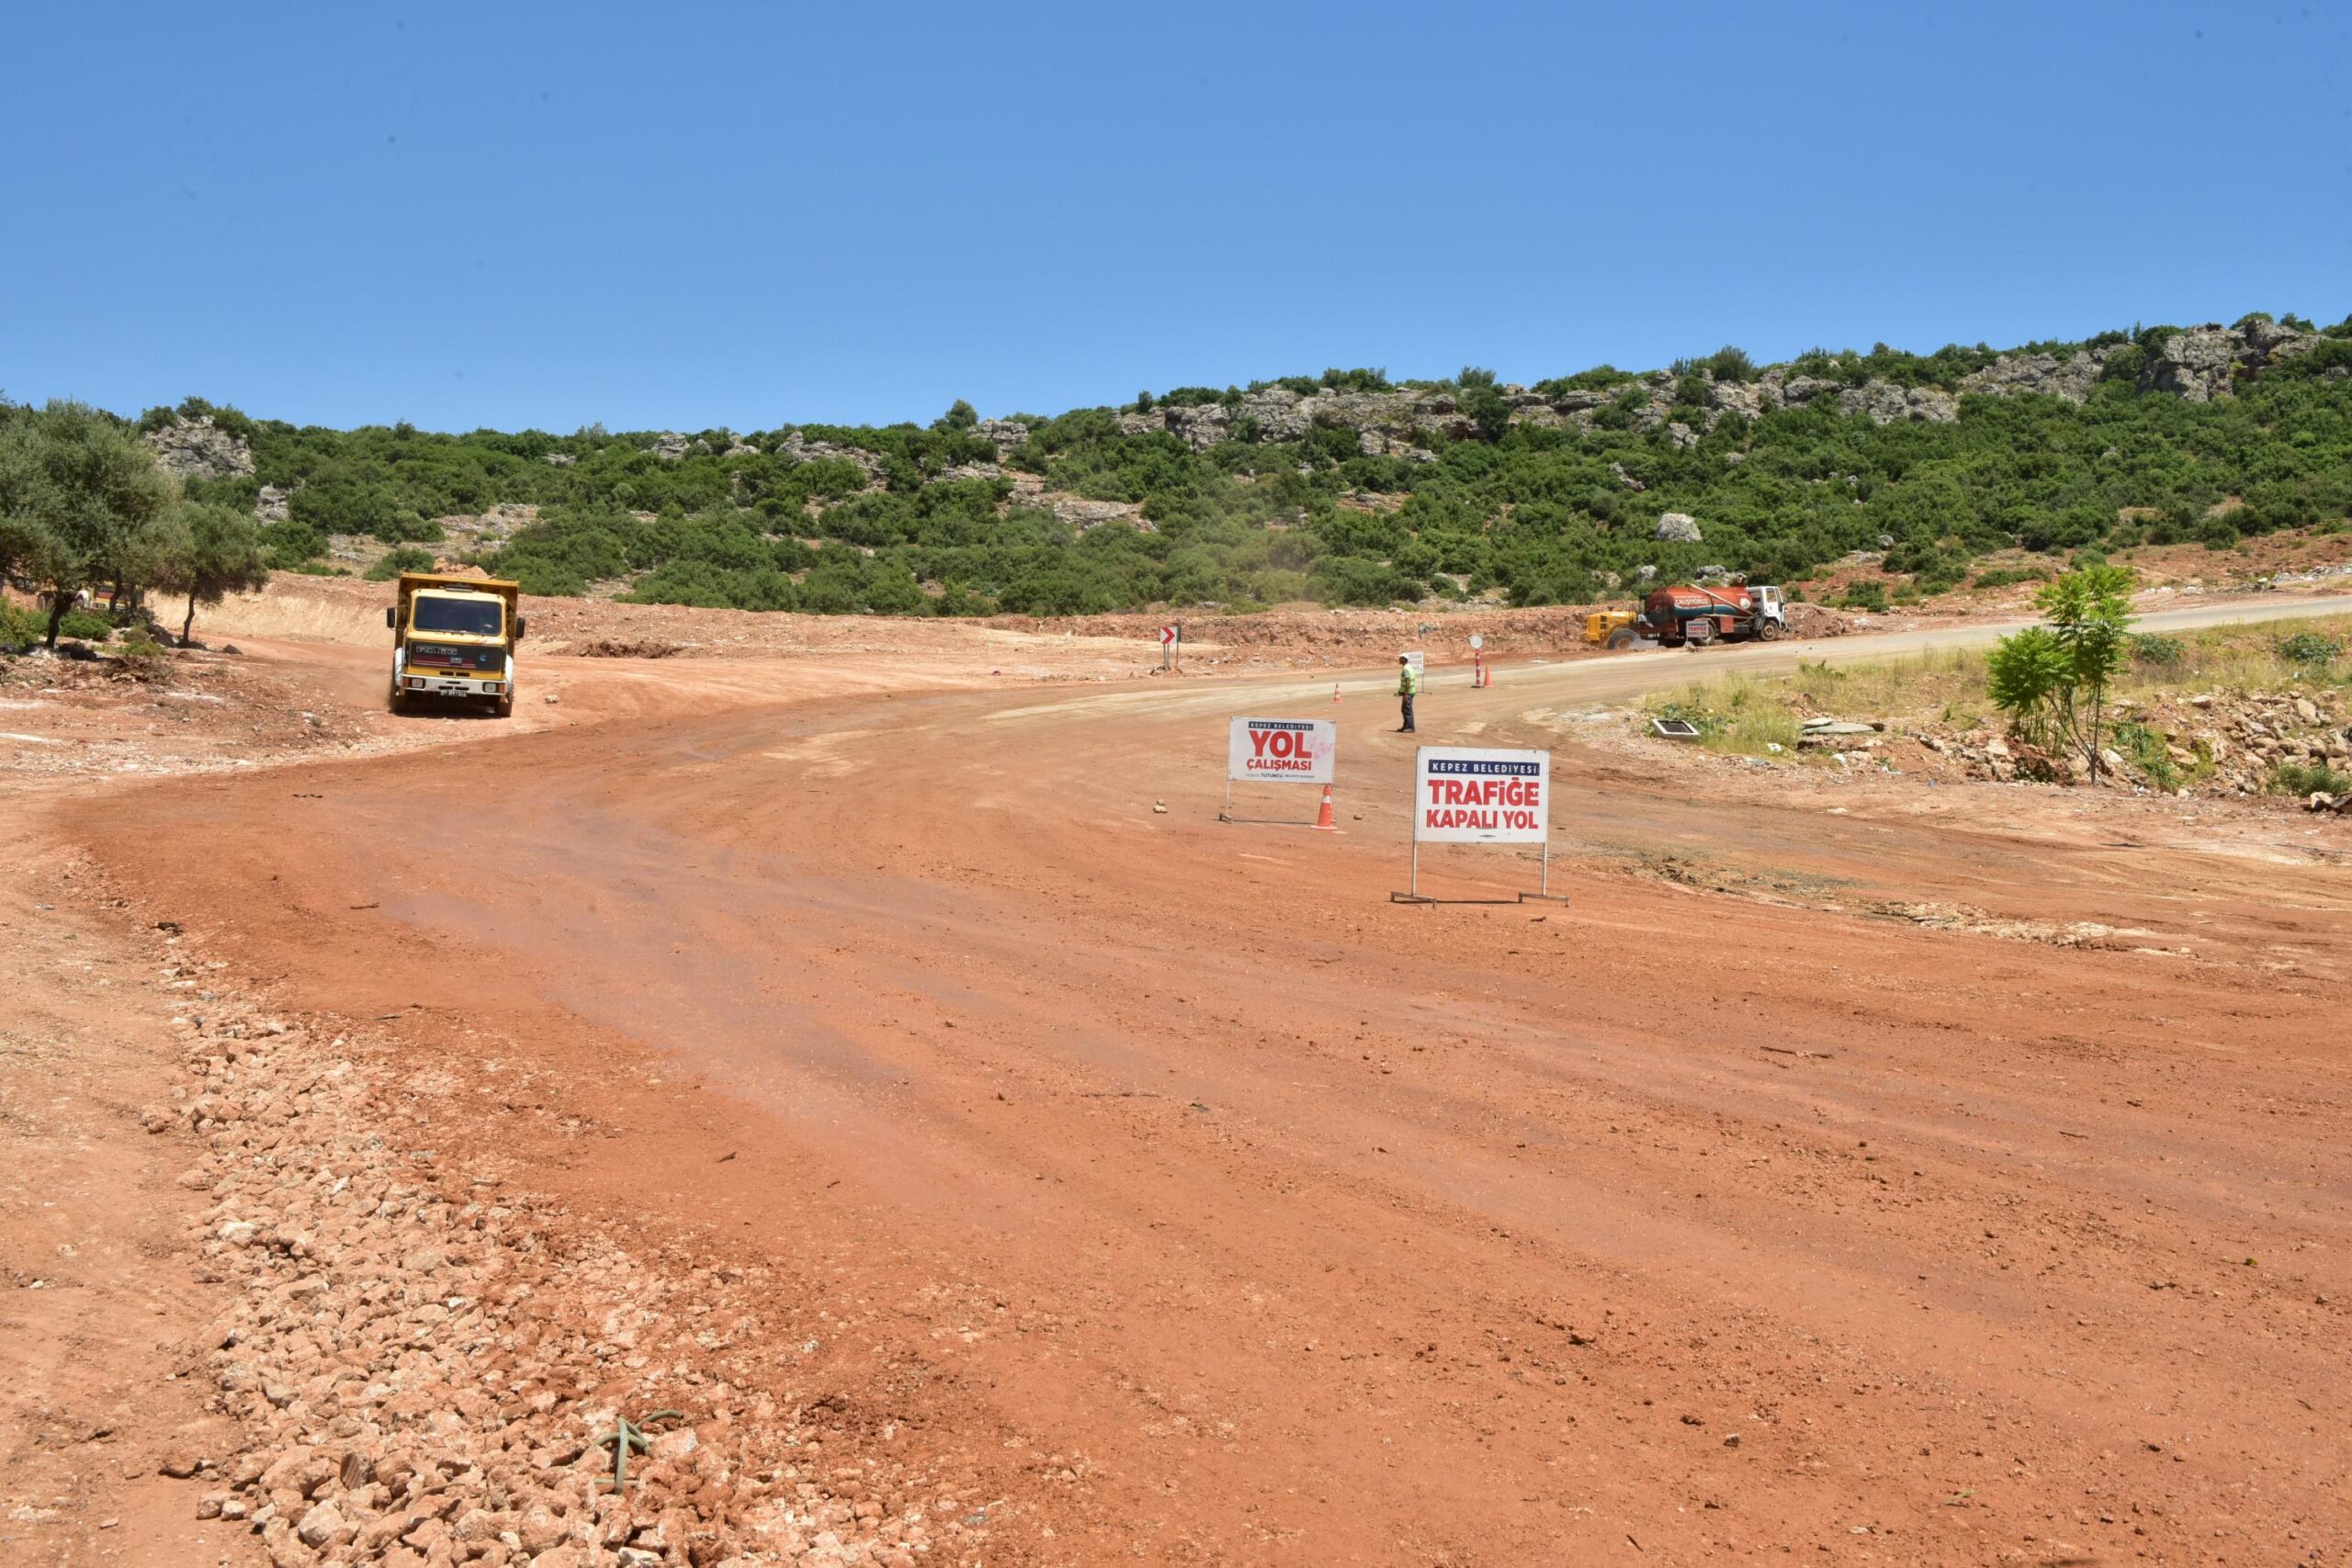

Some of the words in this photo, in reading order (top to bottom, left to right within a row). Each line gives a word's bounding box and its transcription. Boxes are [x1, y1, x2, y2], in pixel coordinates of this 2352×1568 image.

[1249, 730, 1312, 759] YOL
[1246, 759, 1312, 771] ÇALIŞMASI
[1432, 762, 1467, 772] KEPEZ
[1474, 763, 1537, 774] BELEDİYESİ
[1427, 776, 1540, 807] TRAFİĞE
[1426, 808, 1498, 829] KAPALI
[1502, 810, 1539, 829] YOL
